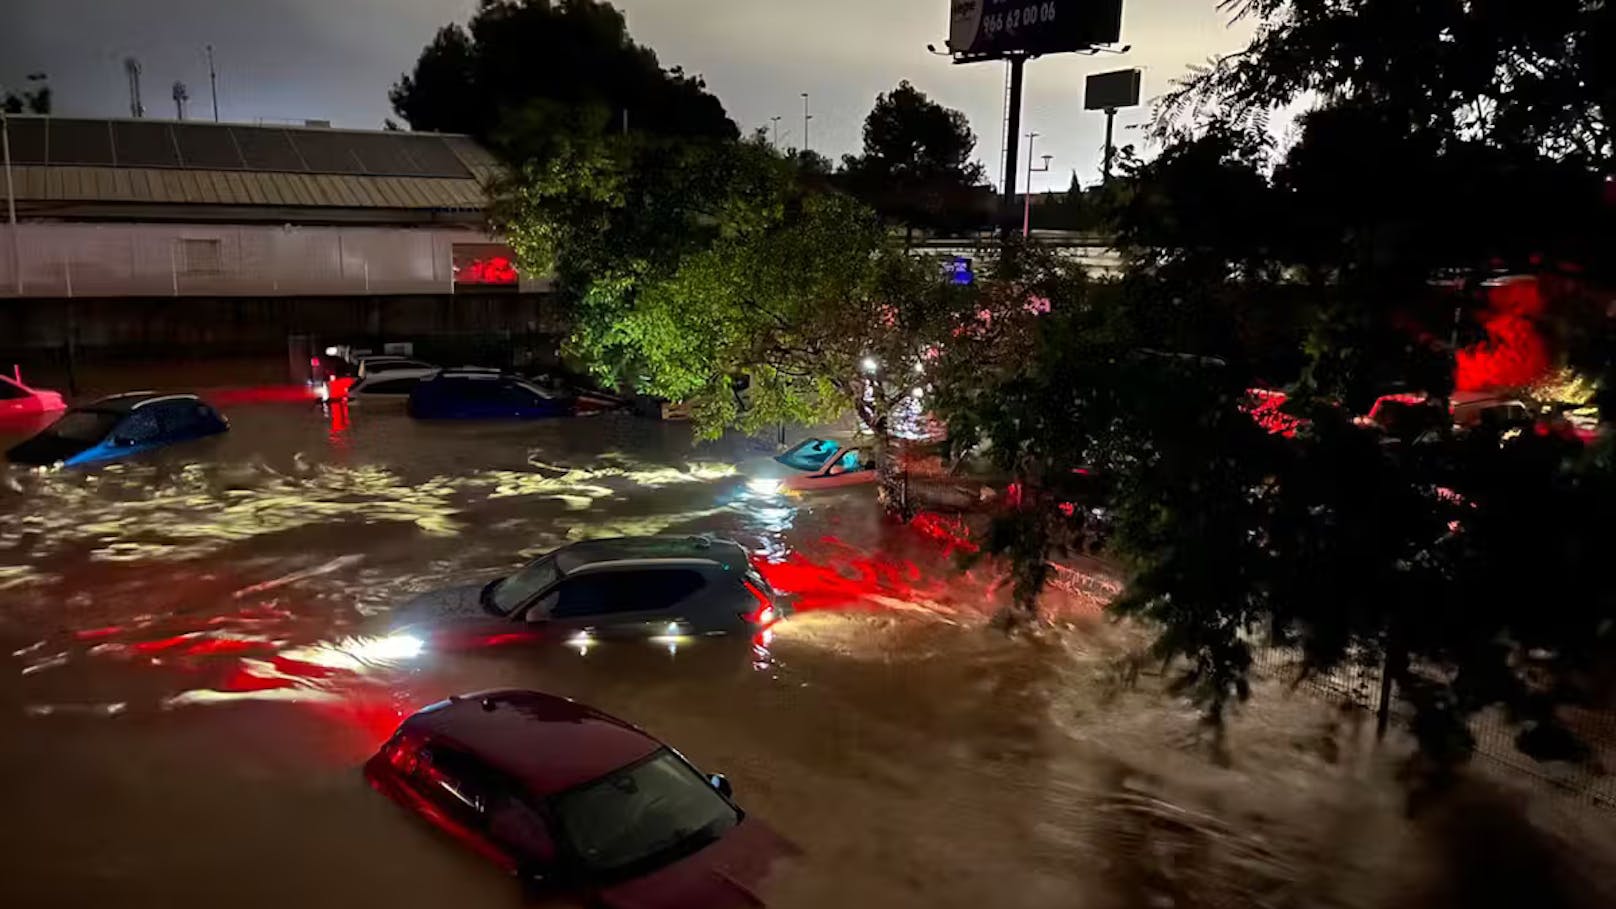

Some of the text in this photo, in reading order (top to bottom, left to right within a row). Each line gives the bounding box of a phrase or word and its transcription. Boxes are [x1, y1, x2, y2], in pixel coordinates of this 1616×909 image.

[1006, 9, 1020, 29] 62
[1023, 5, 1038, 26] 00
[1040, 1, 1056, 22] 06
